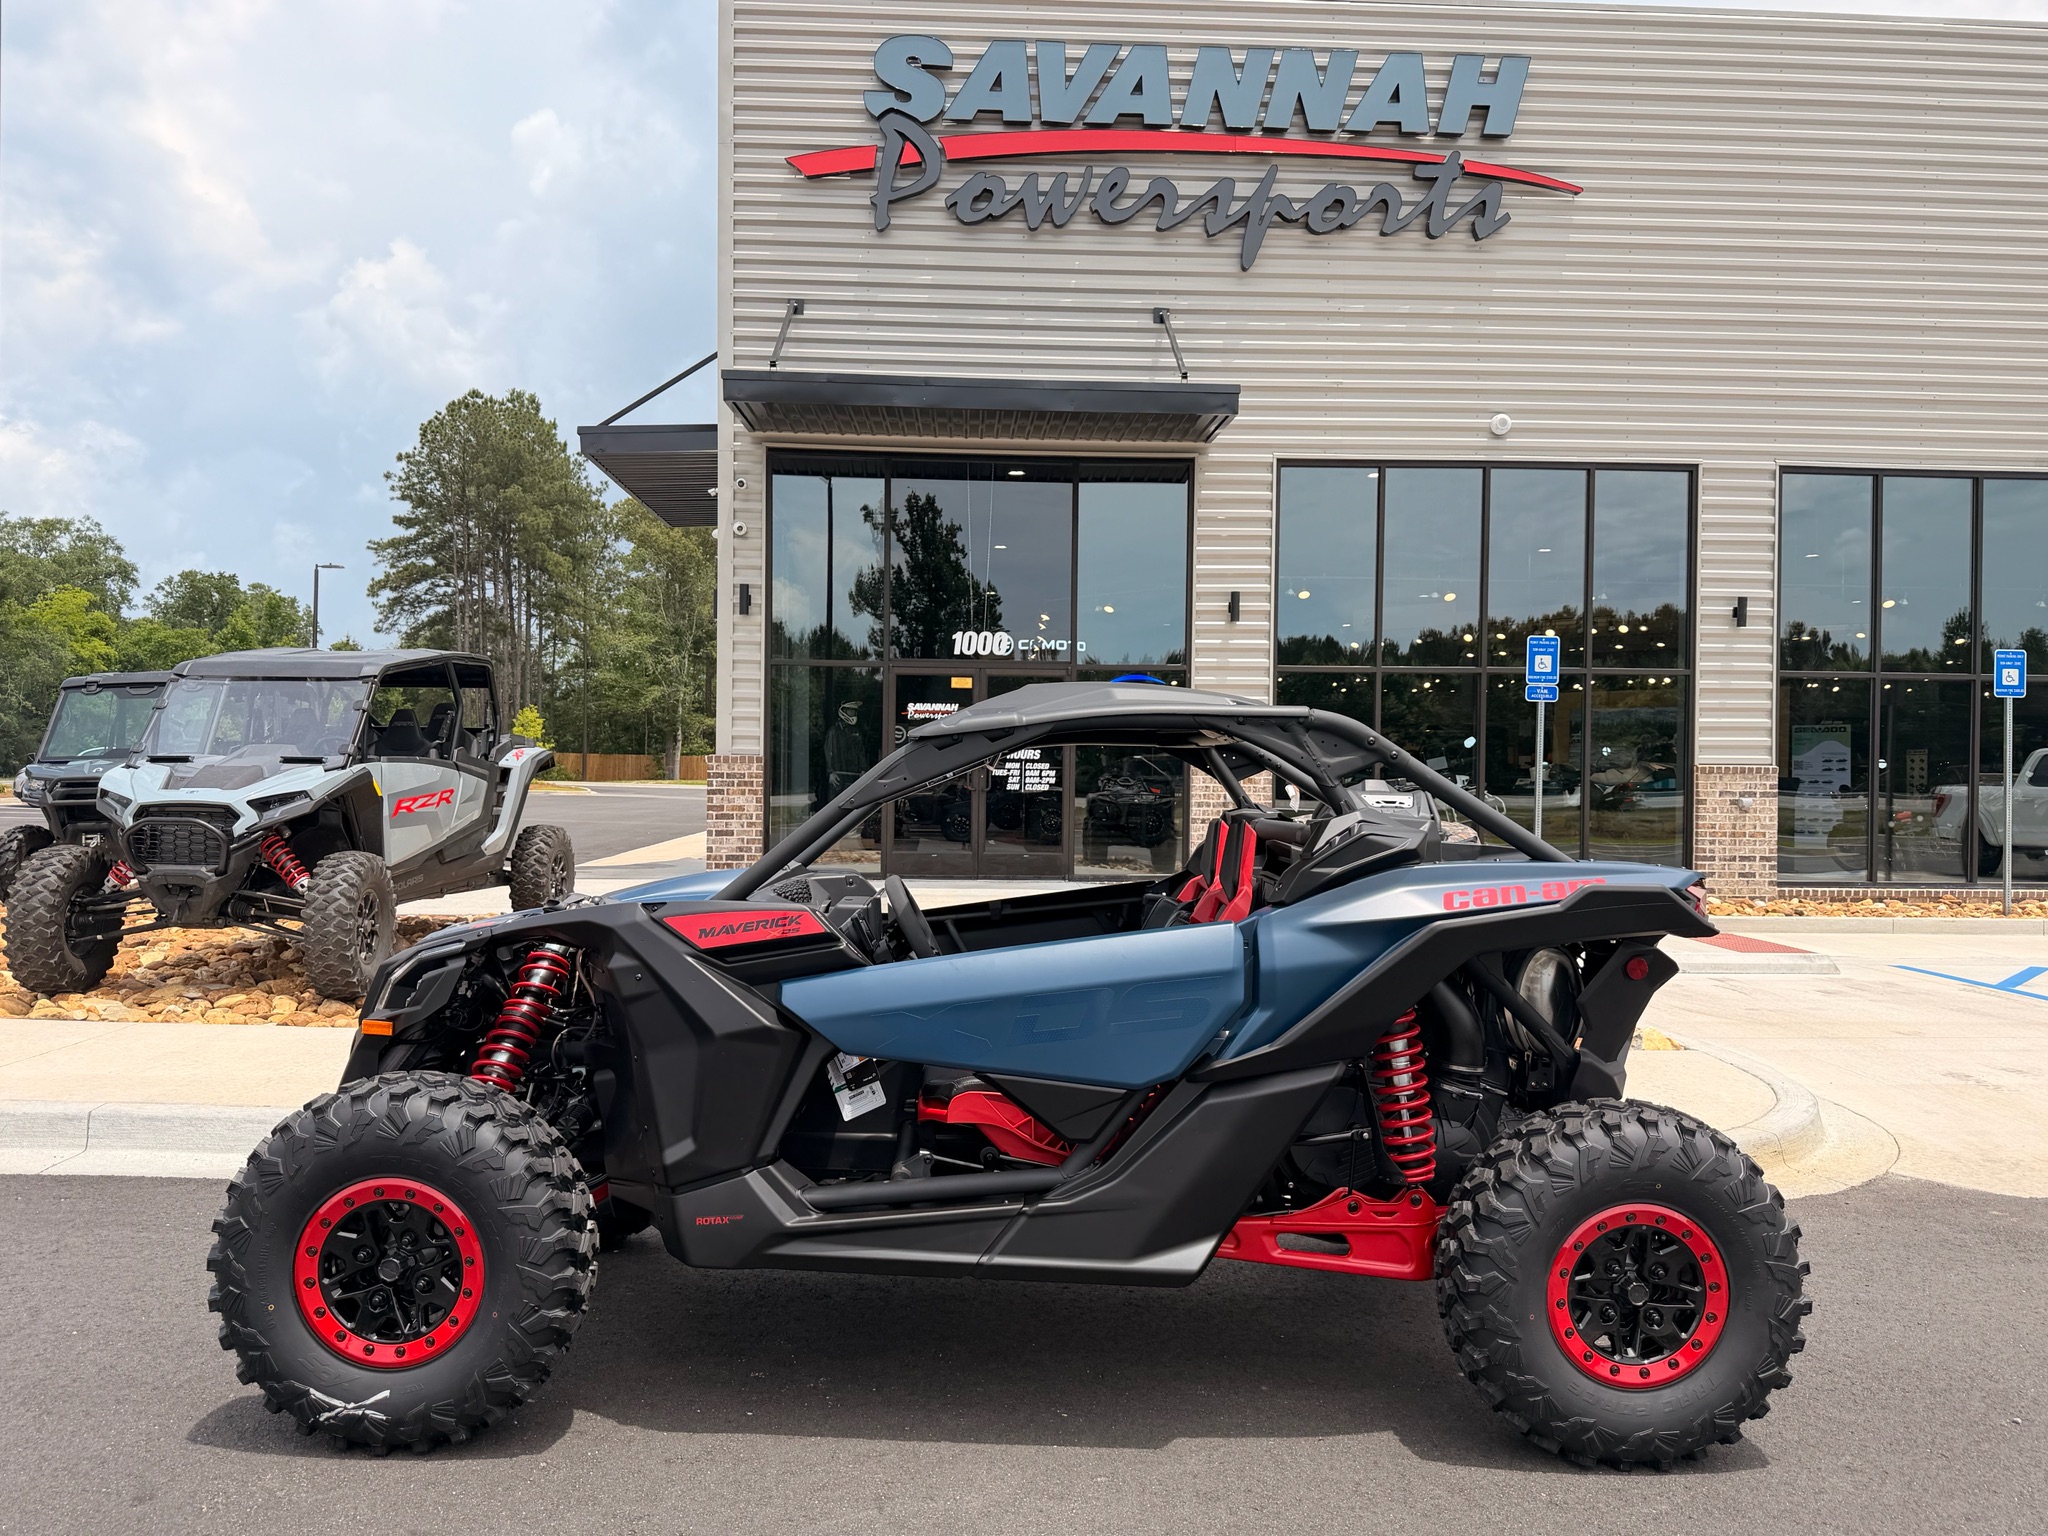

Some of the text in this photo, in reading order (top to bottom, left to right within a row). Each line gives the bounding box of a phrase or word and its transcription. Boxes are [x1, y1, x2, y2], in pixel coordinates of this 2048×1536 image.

[863, 34, 1530, 138] SAVANNAH
[872, 113, 1510, 271] Powersports
[952, 631, 1009, 656] 1000
[907, 702, 959, 712] SAVANNAH
[391, 788, 455, 818] RZR
[698, 914, 803, 939] MAVERICK
[695, 1216, 730, 1226] ROTAX
